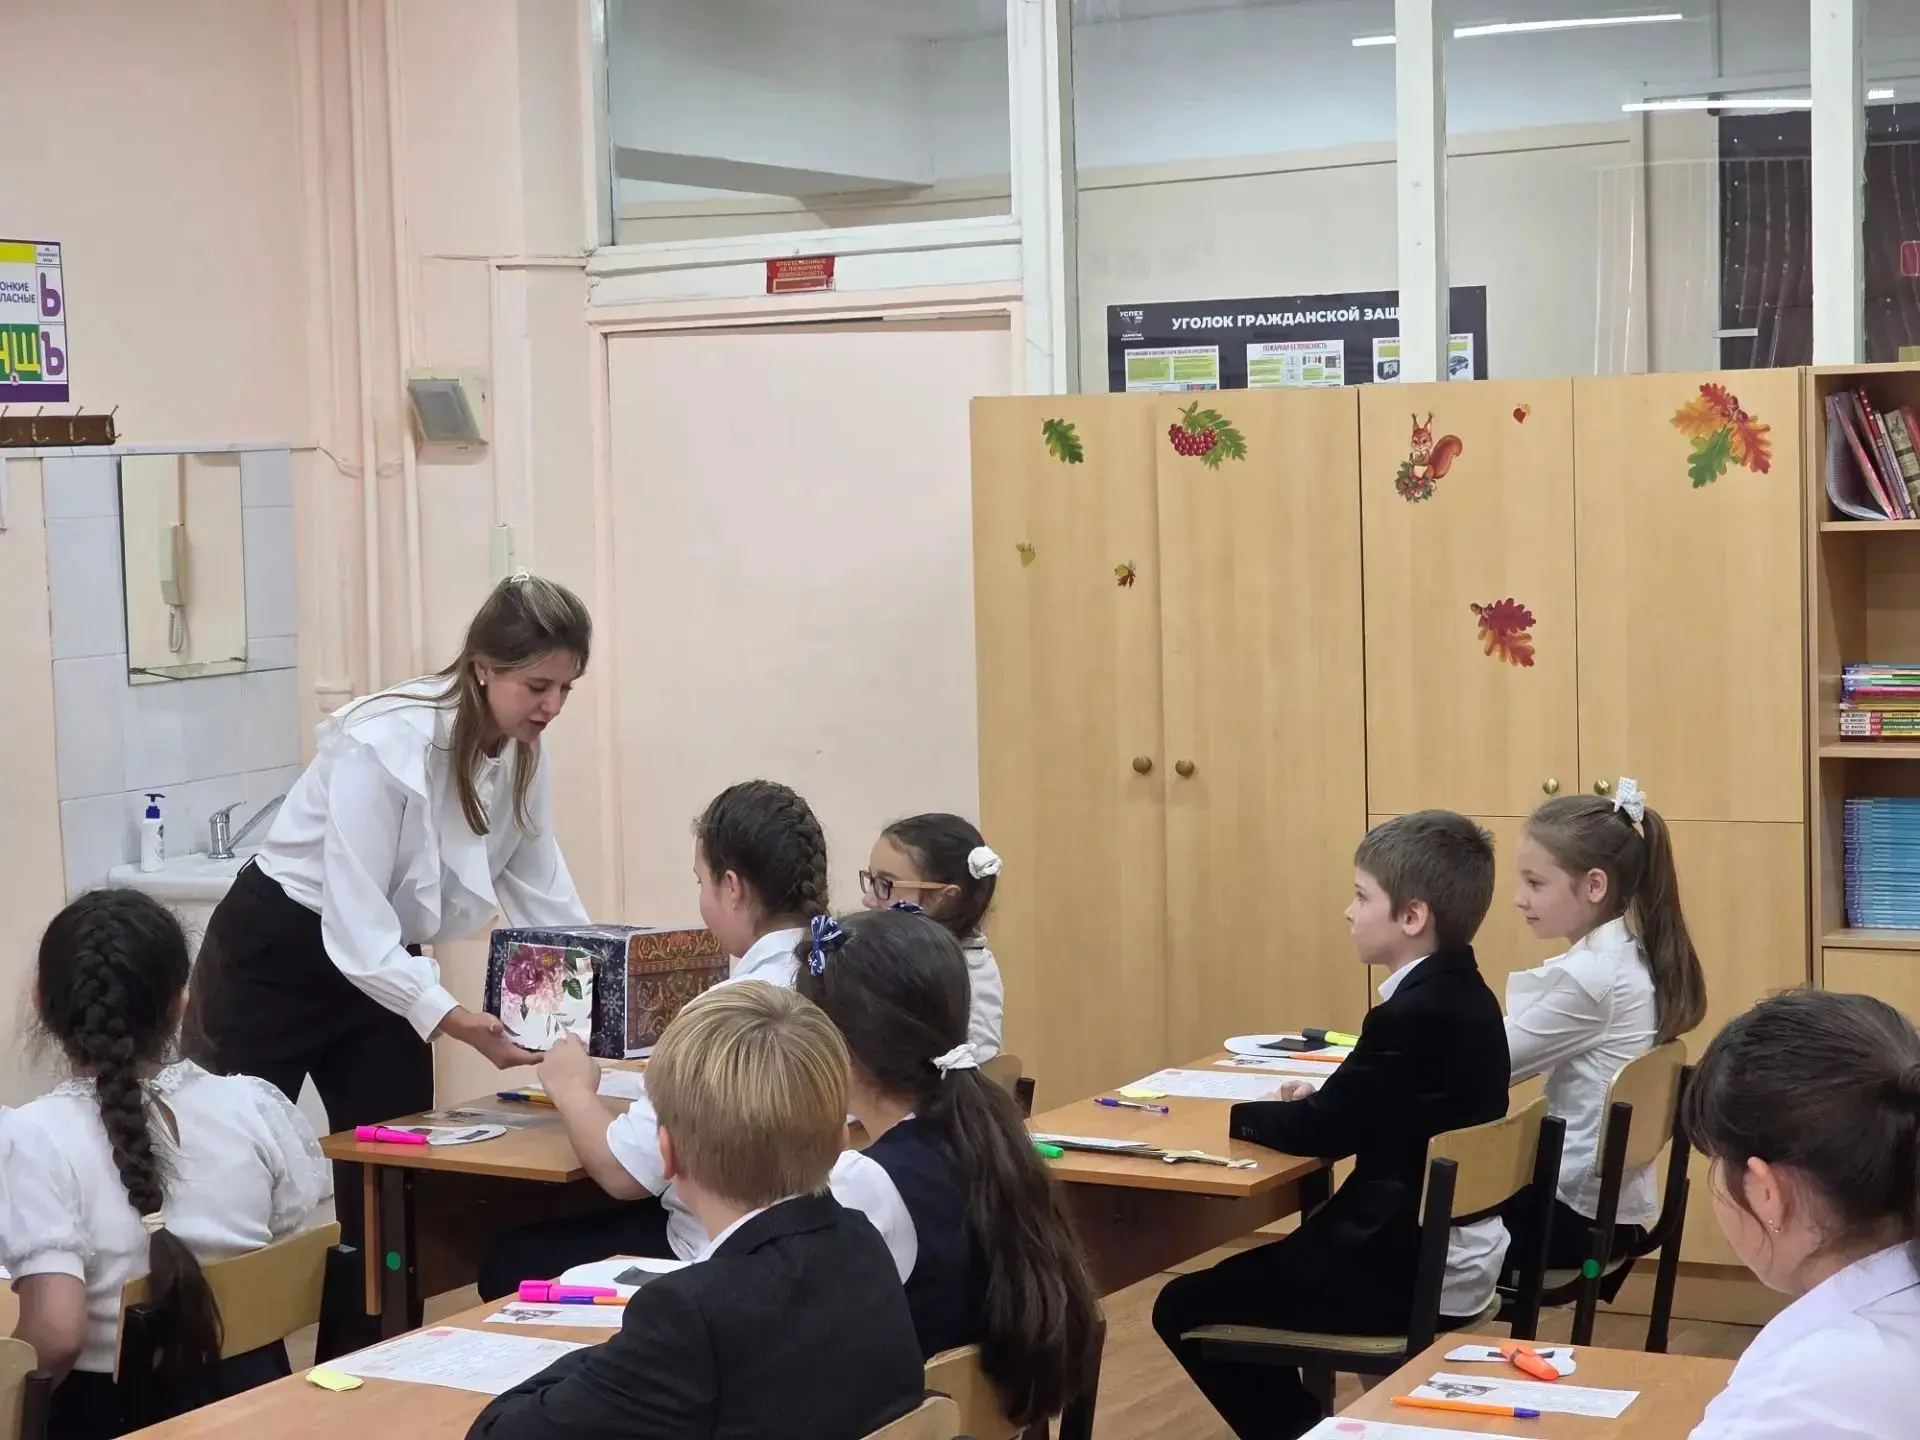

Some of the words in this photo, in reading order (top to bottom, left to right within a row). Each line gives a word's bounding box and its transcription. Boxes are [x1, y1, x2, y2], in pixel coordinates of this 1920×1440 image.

[0, 281, 29, 292] ОНКИЕ
[1172, 315, 1234, 330] УГОЛОК
[1237, 306, 1360, 328] ГРАЖДАНСКОЙ
